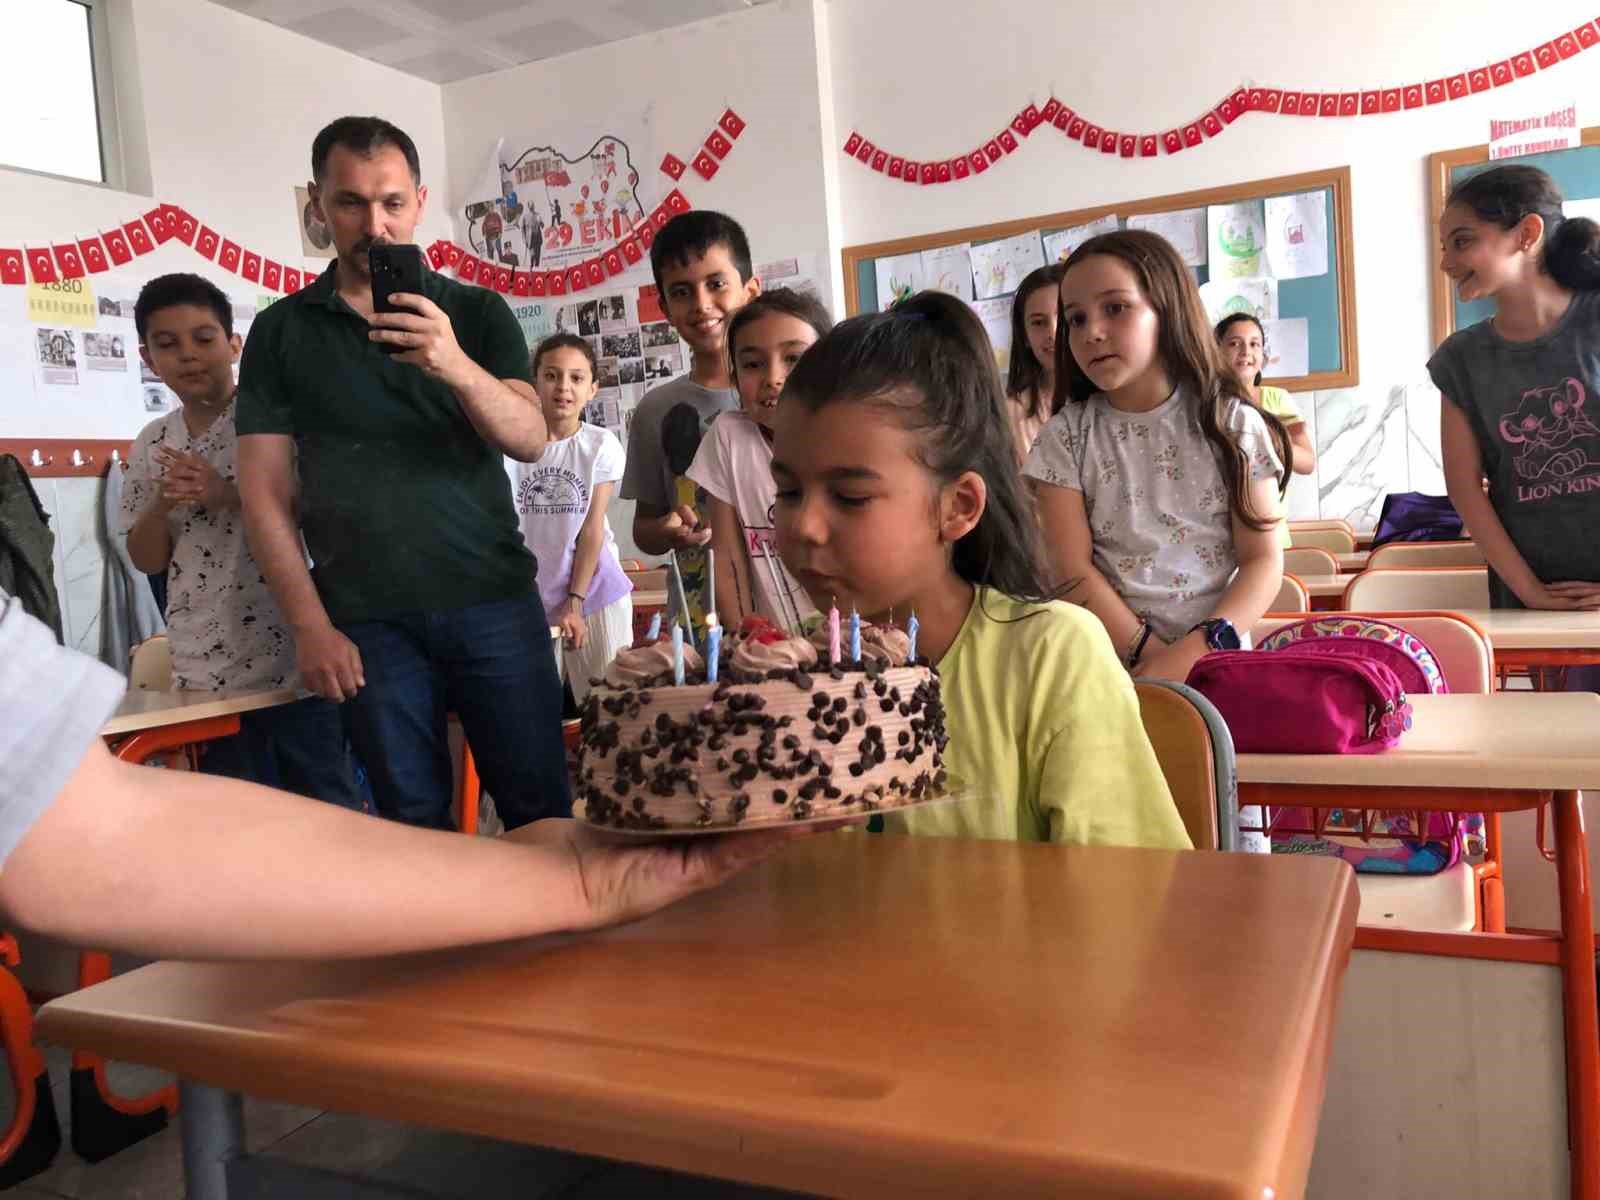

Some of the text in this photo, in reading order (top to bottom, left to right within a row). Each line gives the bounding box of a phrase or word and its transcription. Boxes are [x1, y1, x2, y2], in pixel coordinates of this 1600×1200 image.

[544, 222, 573, 249] 29
[514, 305, 541, 319] 1920
[517, 467, 588, 503] ENJOY EVERY MOMENT
[1517, 483, 1562, 502] LION
[520, 506, 585, 514] OF THIS SUMMER
